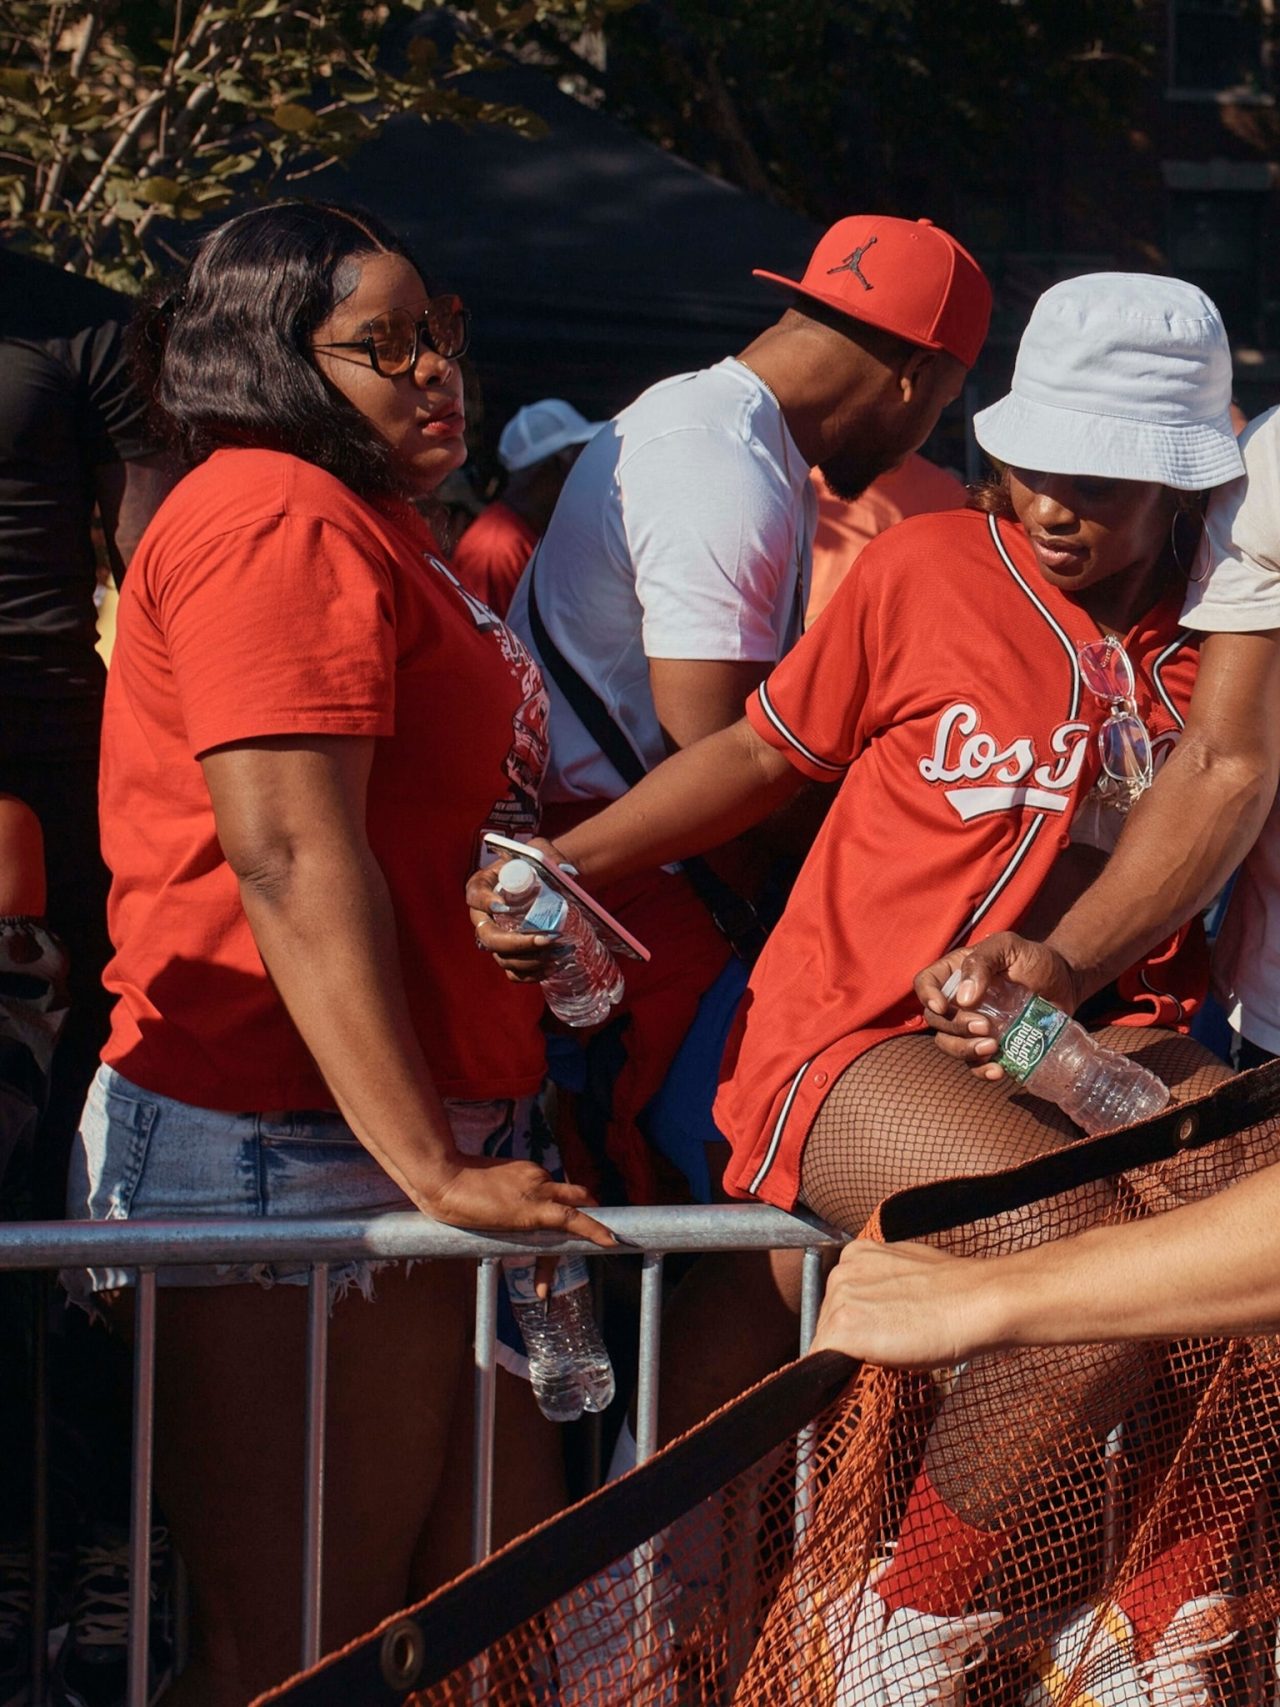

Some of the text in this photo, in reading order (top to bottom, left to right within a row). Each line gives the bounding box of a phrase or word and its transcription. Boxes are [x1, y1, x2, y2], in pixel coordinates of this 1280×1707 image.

[918, 703, 1033, 784] Los
[1005, 1020, 1033, 1062] Poland
[1016, 1026, 1043, 1070] Spring
